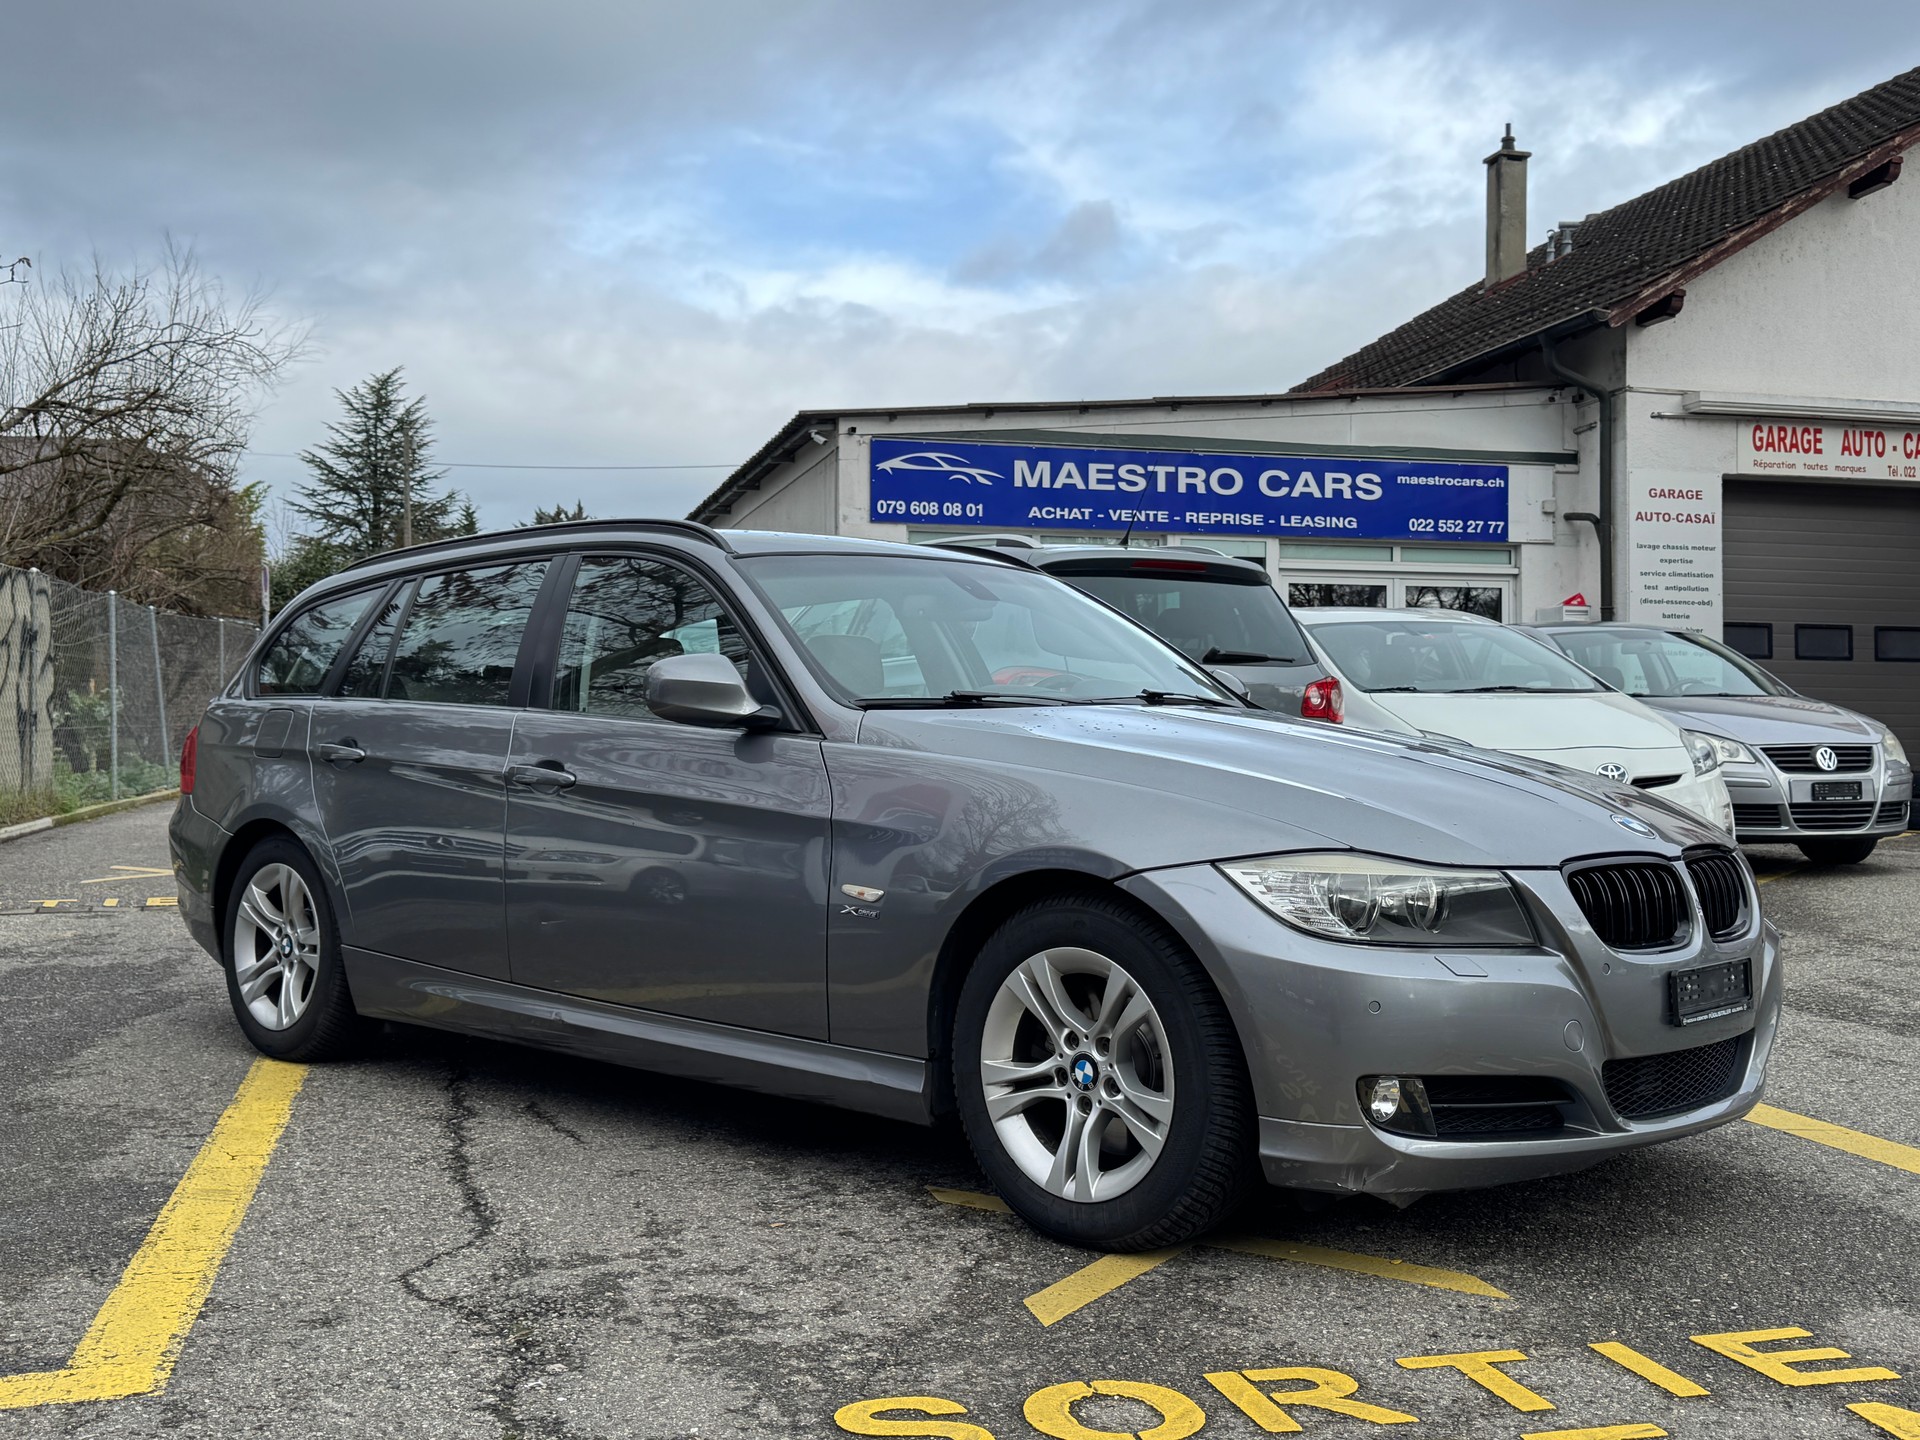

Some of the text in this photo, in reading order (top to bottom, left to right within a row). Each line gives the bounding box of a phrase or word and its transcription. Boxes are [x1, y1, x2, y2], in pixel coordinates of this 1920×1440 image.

[1752, 424, 1823, 455] GARAGE
[1841, 429, 1886, 458] AUTO
[1753, 459, 1867, 474] Réparation toutes marques
[1013, 460, 1383, 501] MAESTRO CARS
[1396, 474, 1505, 488] maestrocars.ch
[1648, 488, 1703, 500] GARAGE
[876, 500, 983, 517] 079 608 08 01
[1028, 506, 1093, 521] ACHAT
[1109, 509, 1169, 523] VENTE
[1185, 512, 1264, 526] REPRISE
[1280, 515, 1358, 529] LEASING
[1408, 518, 1505, 534] 022 552 27 77
[1636, 543, 1661, 551] lavage
[1659, 557, 1694, 566] expertise
[1668, 571, 1714, 579] climatisation
[1664, 585, 1710, 594] antipollution
[1662, 612, 1691, 620] batterie
[833, 1327, 1901, 1440] SORTIE
